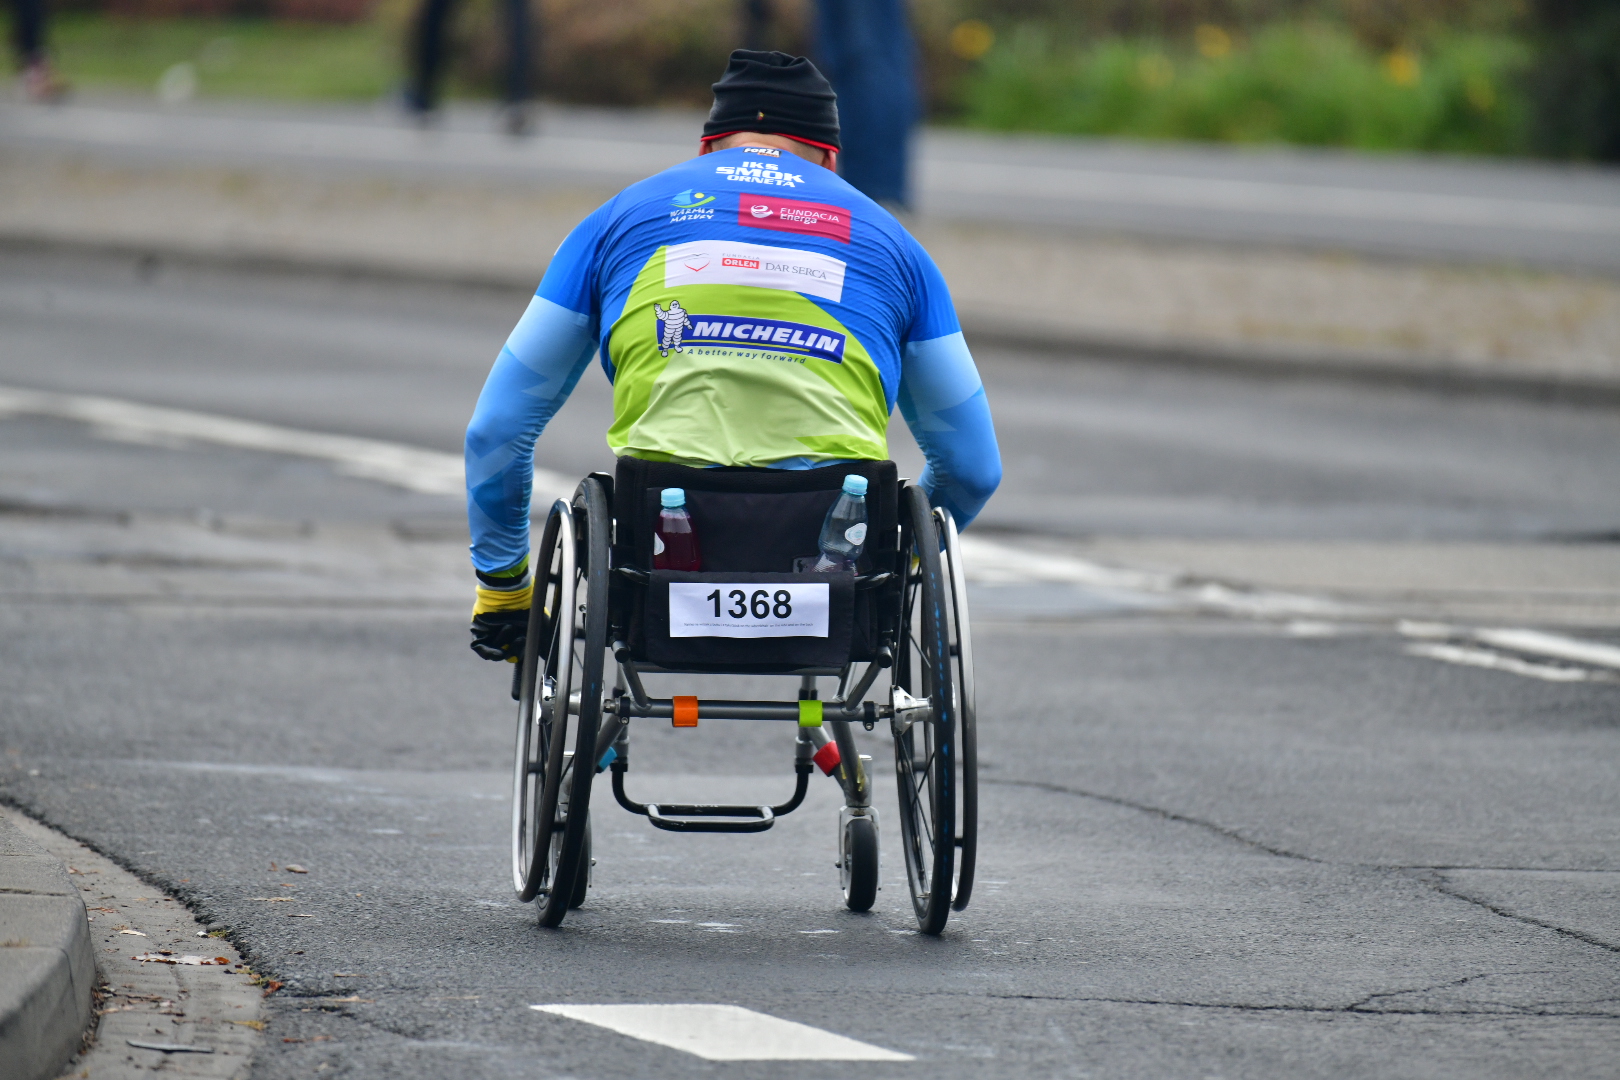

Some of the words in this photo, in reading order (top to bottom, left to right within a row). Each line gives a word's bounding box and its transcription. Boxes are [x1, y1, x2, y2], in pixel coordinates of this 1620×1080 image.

[743, 148, 780, 156] FORZA
[742, 161, 779, 171] IKS
[715, 166, 805, 183] SMOK
[726, 174, 796, 188] ORNETA
[670, 214, 714, 224] MAZURY
[780, 207, 840, 222] FUNDACJA
[780, 213, 818, 225] Energa
[723, 258, 757, 268] ORLEN
[765, 262, 790, 273] DAR
[791, 266, 827, 280] SERCA
[692, 321, 840, 352] MICHELIN
[697, 348, 733, 357] better
[736, 351, 758, 360] way
[761, 352, 806, 364] forward
[706, 589, 793, 619] 1368
